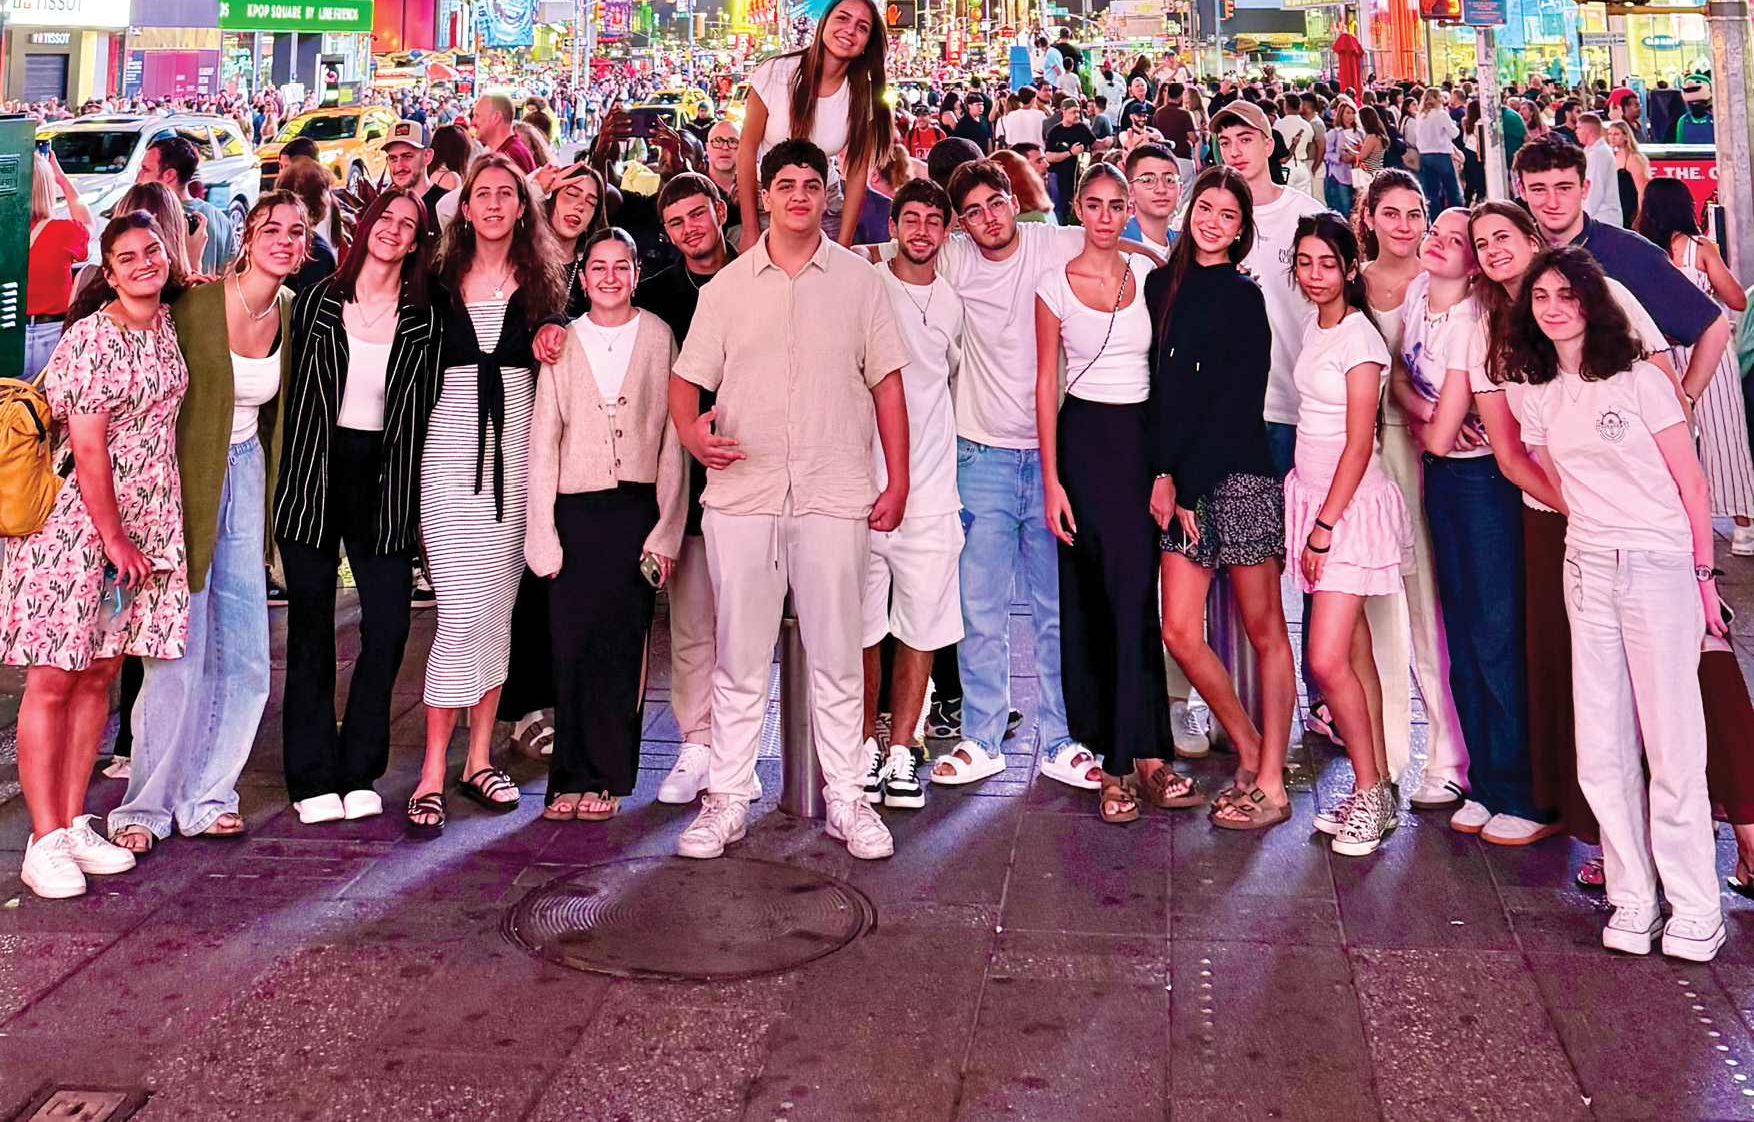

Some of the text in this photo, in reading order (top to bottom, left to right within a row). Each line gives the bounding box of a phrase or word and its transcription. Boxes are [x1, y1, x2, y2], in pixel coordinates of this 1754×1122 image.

[247, 4, 270, 18] KPOP
[271, 5, 302, 19] SQUARE
[305, 6, 315, 19] BY
[44, 32, 71, 44] TISSOT
